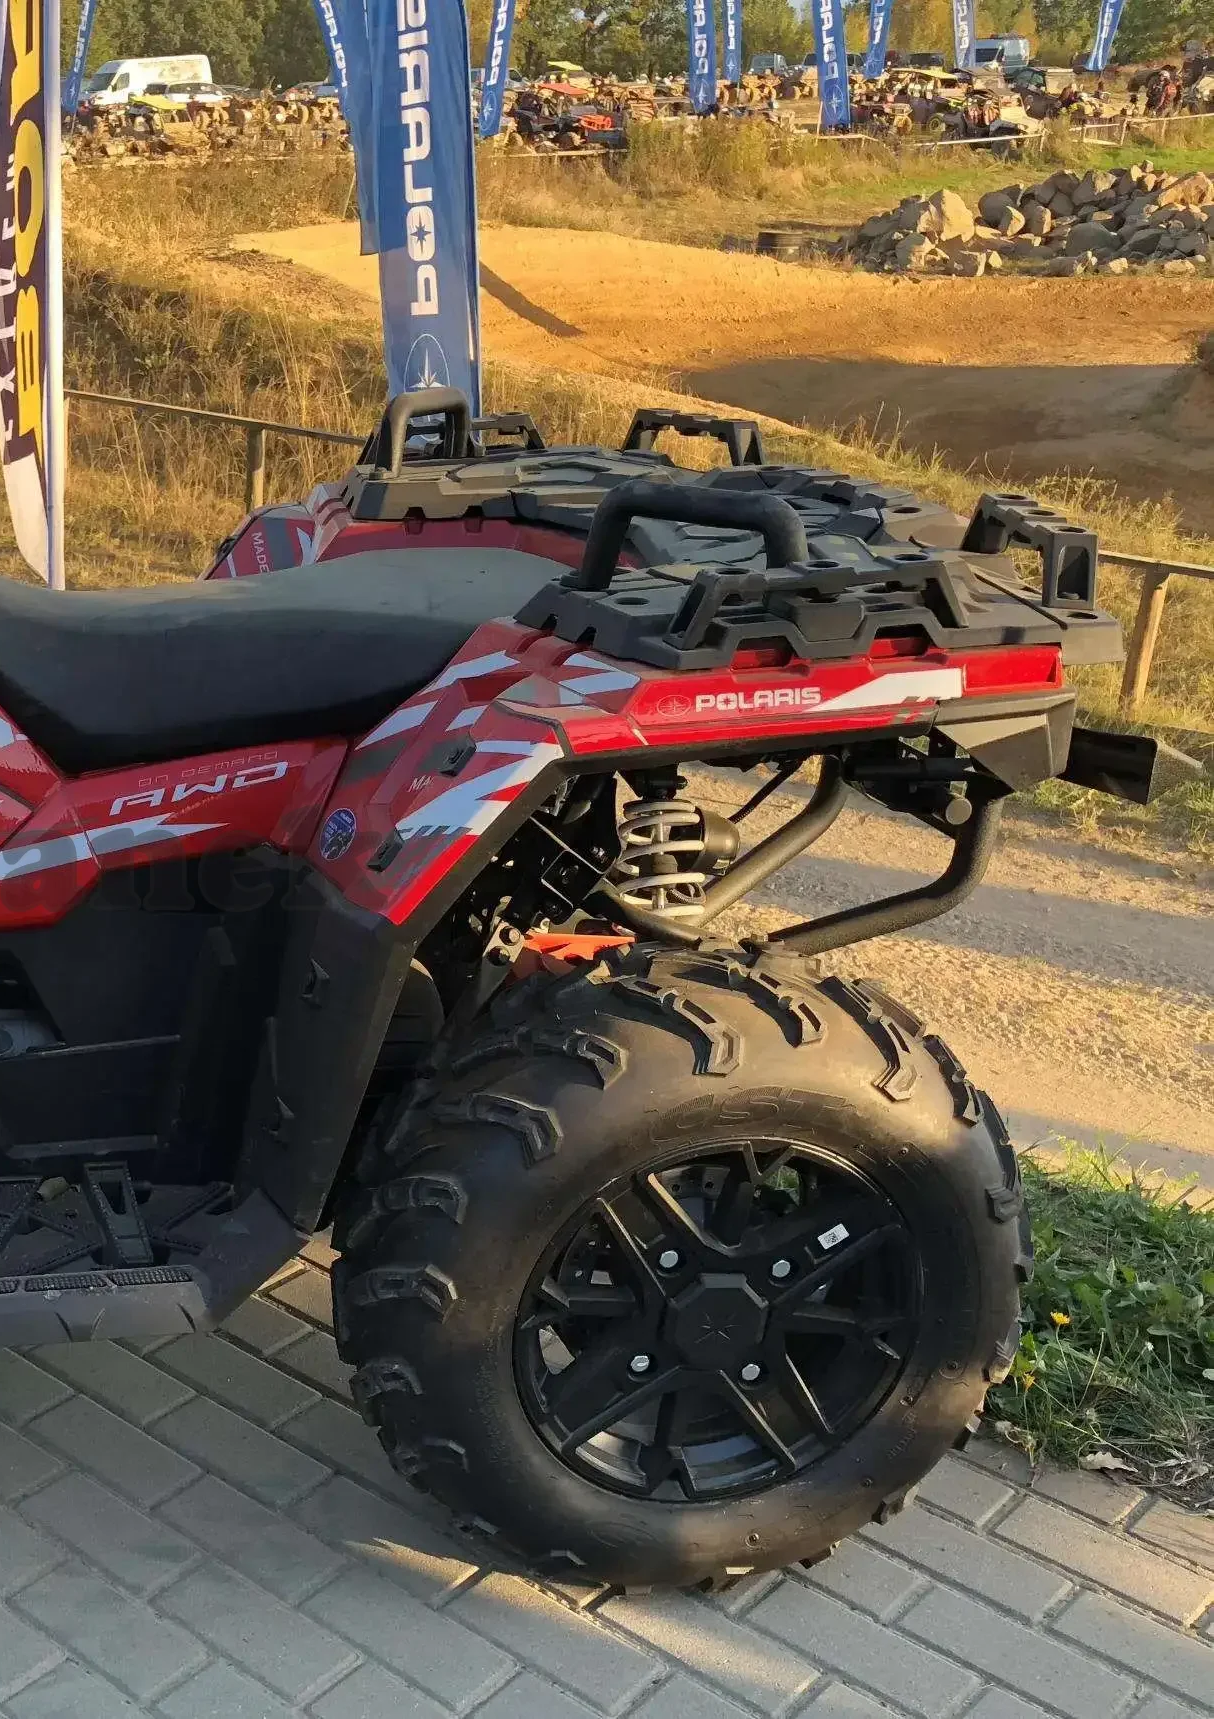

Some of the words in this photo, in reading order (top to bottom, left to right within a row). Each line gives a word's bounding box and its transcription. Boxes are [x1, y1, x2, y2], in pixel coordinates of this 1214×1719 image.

[251, 531, 270, 573] MADE
[695, 686, 821, 712] POLARIS
[109, 761, 289, 816] AWD
